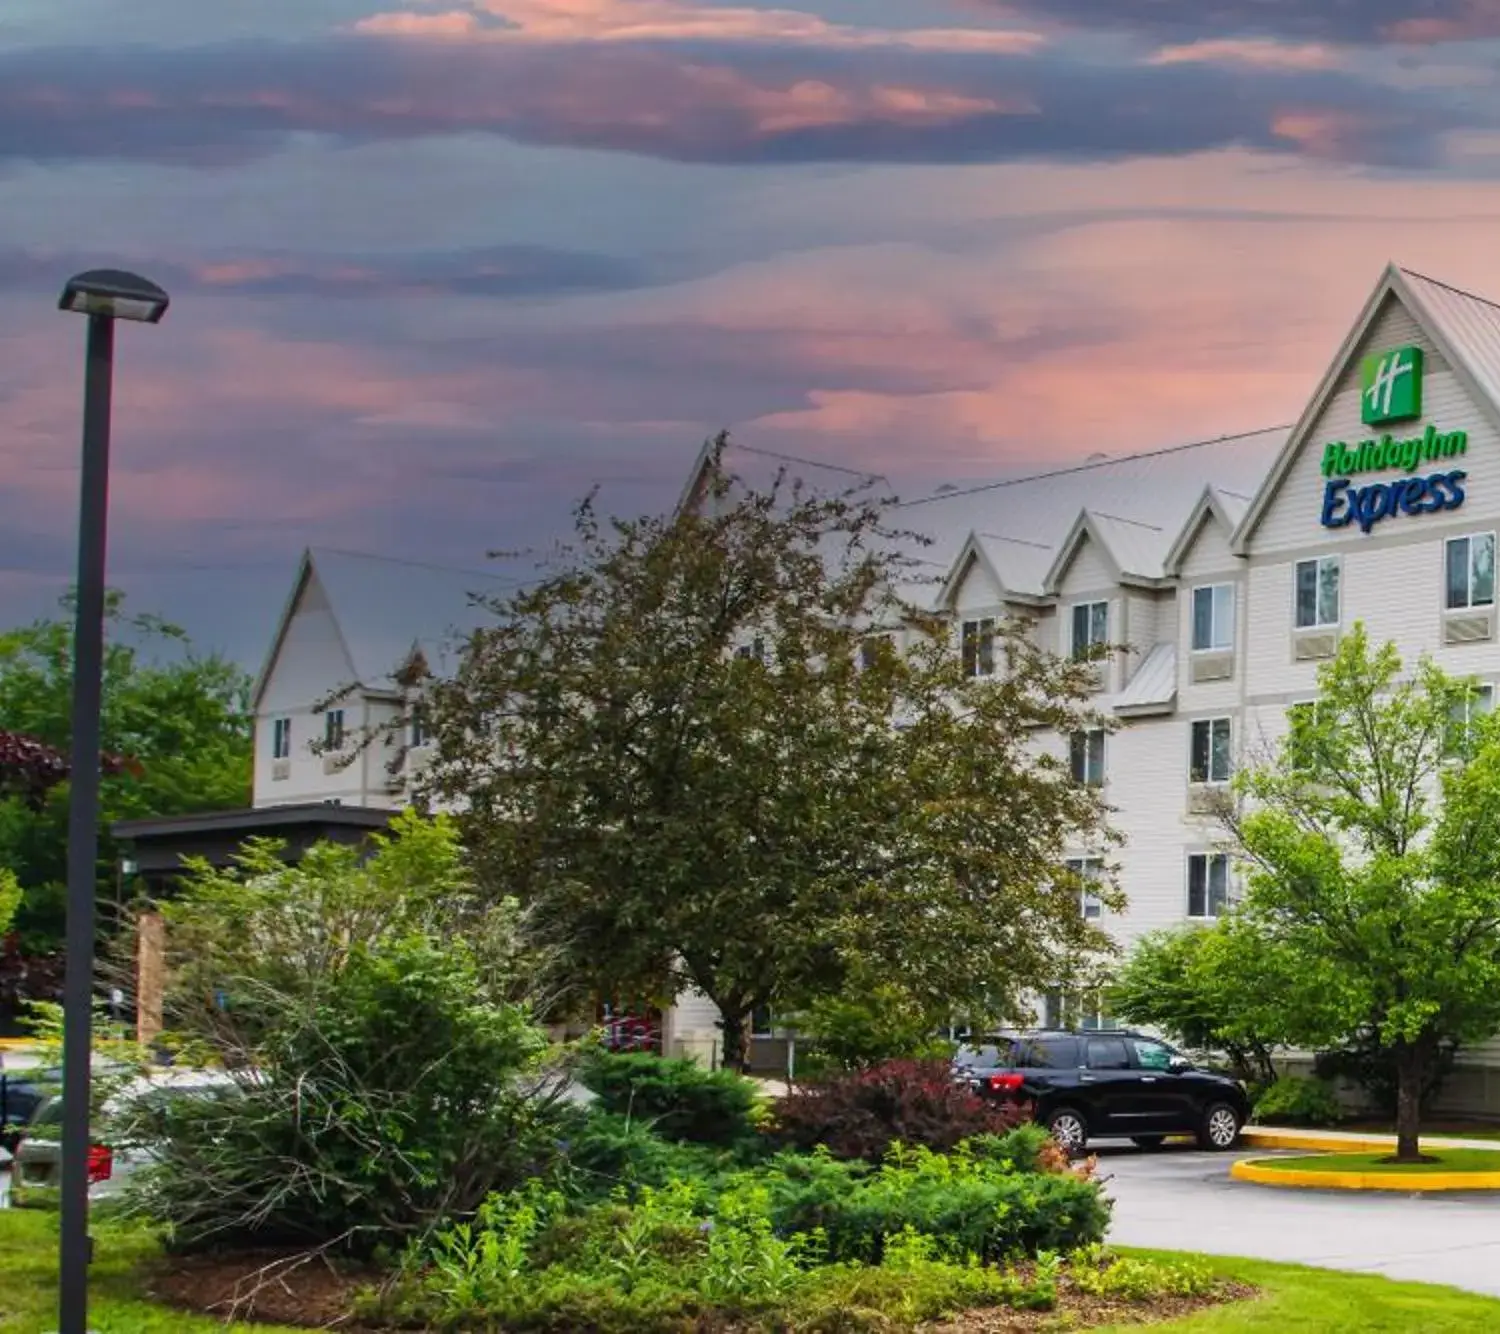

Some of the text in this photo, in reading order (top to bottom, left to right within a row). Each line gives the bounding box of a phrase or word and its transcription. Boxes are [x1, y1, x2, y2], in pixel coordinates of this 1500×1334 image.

[1367, 352, 1413, 415] H
[1321, 425, 1468, 477] Holiday Inn
[1320, 469, 1468, 534] Express
